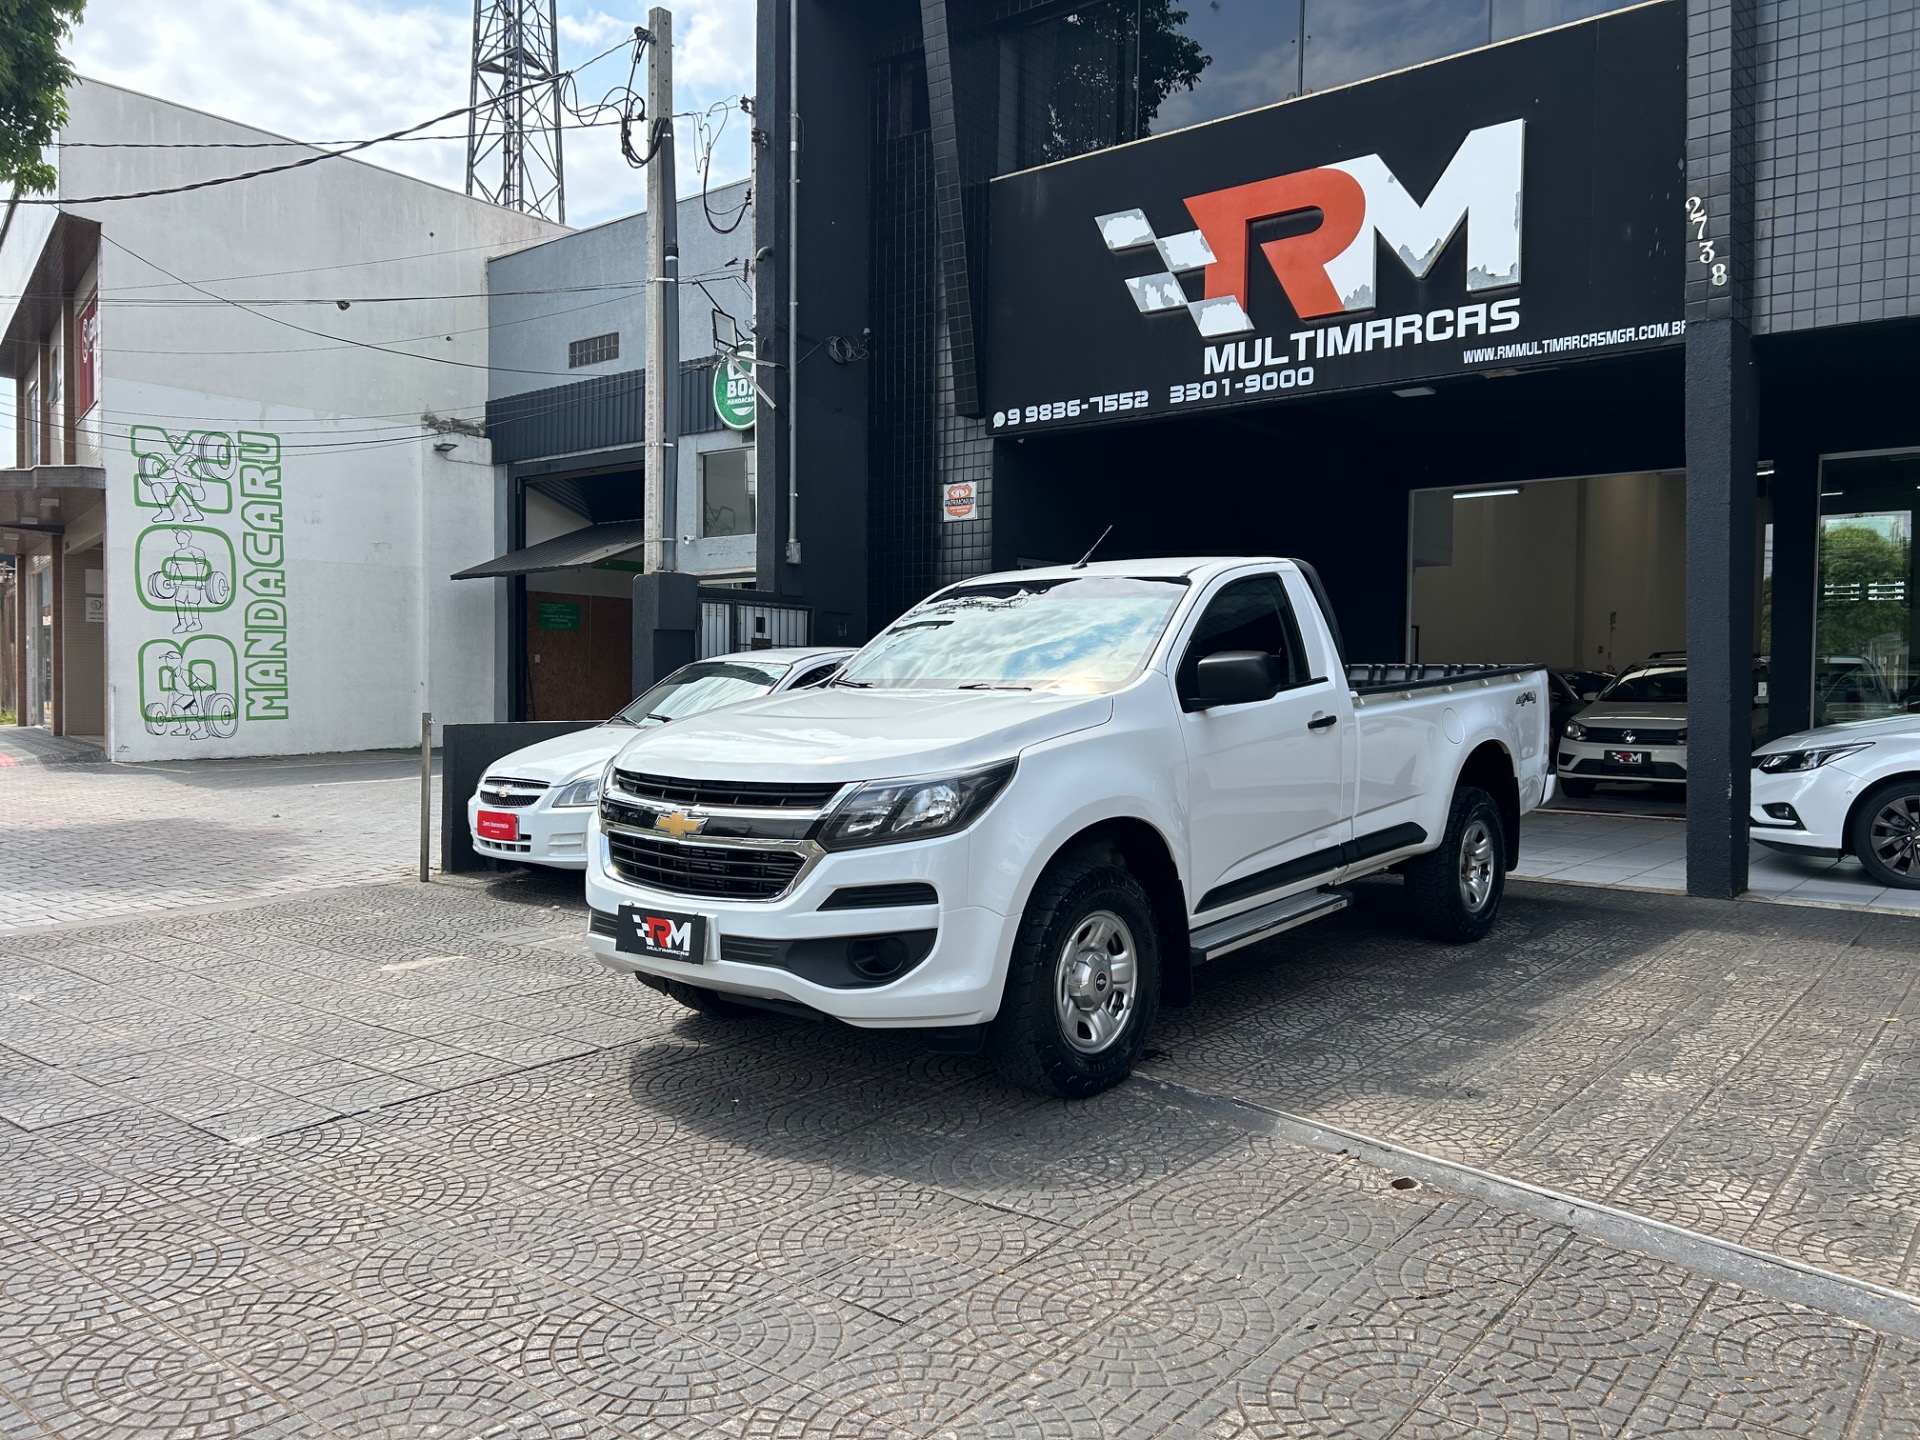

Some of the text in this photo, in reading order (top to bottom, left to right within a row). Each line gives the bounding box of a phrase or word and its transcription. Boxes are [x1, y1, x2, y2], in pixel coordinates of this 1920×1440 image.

[1183, 118, 1526, 320] RM
[1685, 196, 1728, 286] 2738
[1203, 298, 1521, 375] MULTIMARCAS
[1007, 390, 1149, 426] 9 9836-7552
[1169, 366, 1314, 404] 3301-9000
[131, 424, 239, 723] BOX
[238, 429, 289, 722] MANDACARU
[646, 916, 692, 951] RM
